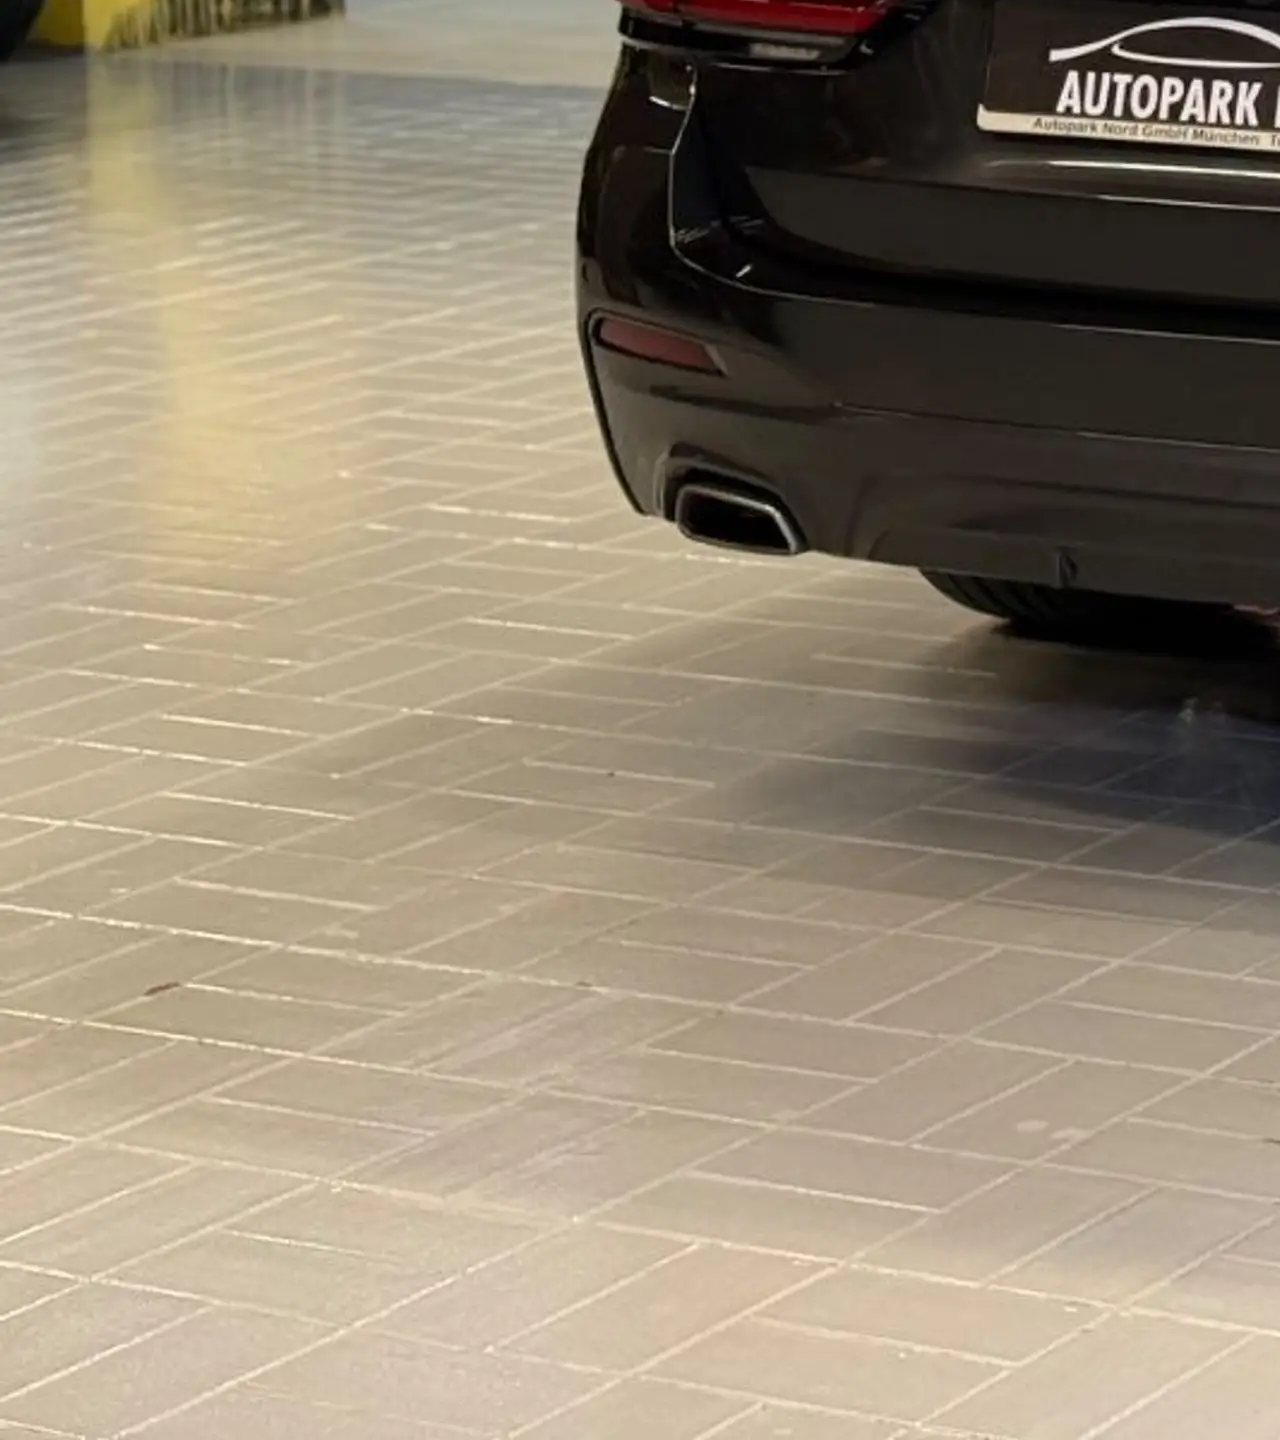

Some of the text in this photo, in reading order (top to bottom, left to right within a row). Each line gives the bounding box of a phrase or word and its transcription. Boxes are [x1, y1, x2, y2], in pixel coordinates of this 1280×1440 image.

[1055, 69, 1262, 126] AUTOPARK
[1033, 116, 1100, 136] Autopark
[1102, 121, 1138, 137] Nord
[1141, 124, 1188, 142] GmbH
